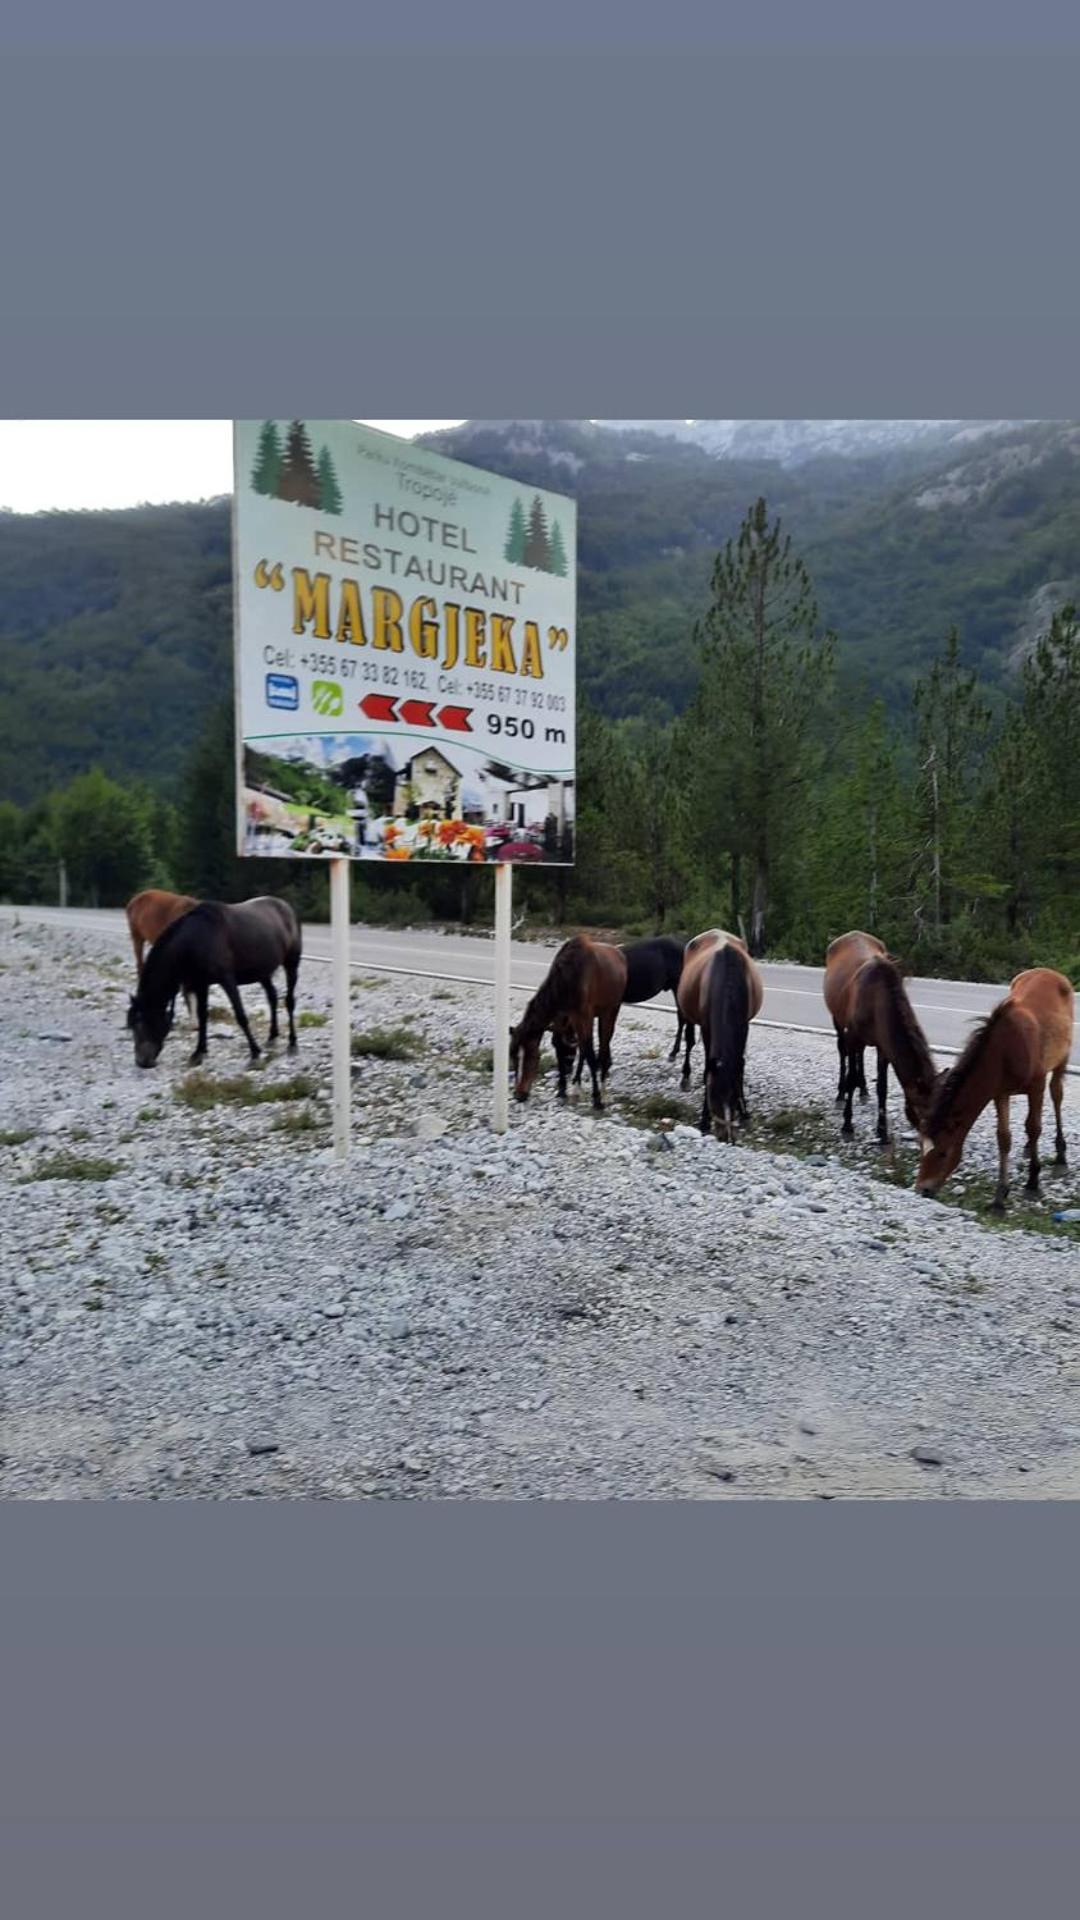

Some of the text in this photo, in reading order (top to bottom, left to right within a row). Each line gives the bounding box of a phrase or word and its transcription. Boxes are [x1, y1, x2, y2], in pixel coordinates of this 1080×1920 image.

[374, 502, 478, 555] HOTEL
[314, 530, 526, 606] RESTAURANT
[263, 644, 295, 668] Cel:
[300, 652, 336, 676] +355
[340, 657, 358, 678] 67
[362, 661, 379, 683] 33
[383, 665, 399, 686] 82
[466, 680, 495, 702] +355
[499, 685, 512, 704] 67
[515, 687, 528, 707] 37
[486, 713, 567, 745] 950 m
